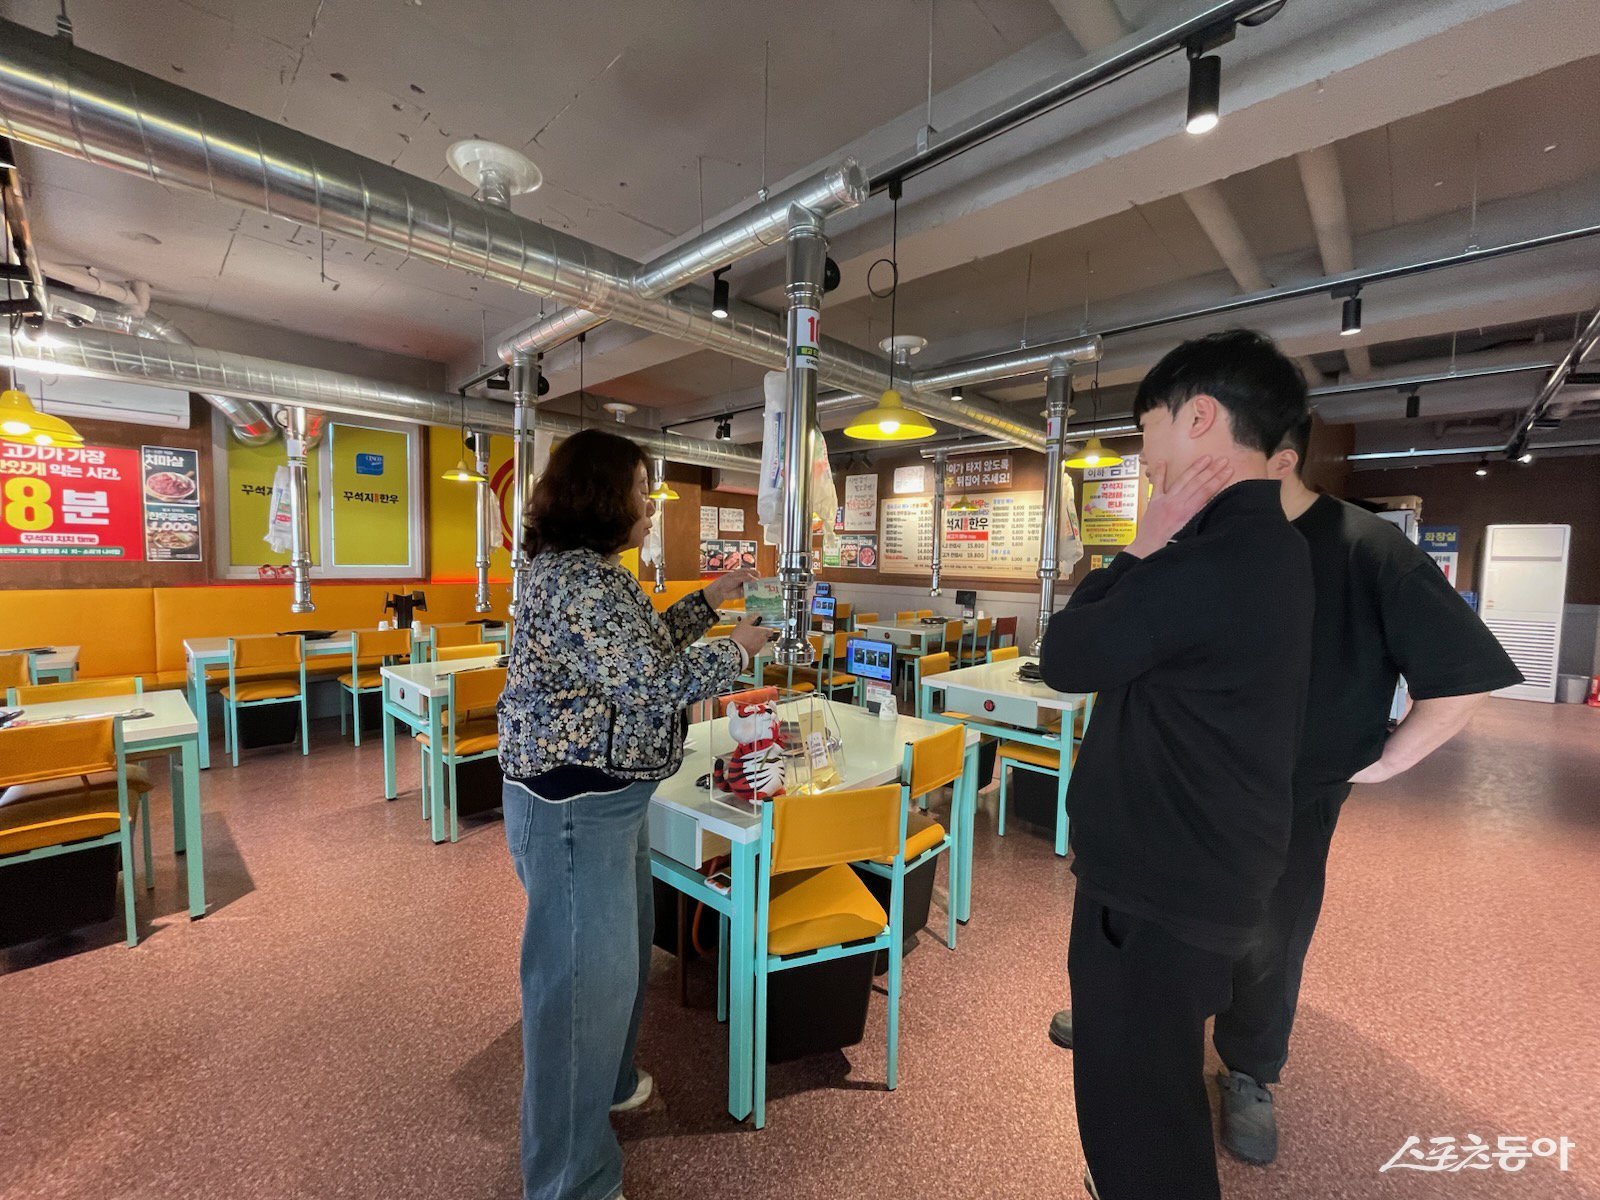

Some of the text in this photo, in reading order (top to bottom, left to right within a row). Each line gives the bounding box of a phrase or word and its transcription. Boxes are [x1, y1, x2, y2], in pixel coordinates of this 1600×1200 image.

[2, 443, 106, 465] 고기가 가장
[145, 454, 184, 468] 치마살
[50, 464, 83, 478] 익는
[86, 467, 122, 480] 시간
[946, 459, 1009, 474] 이가 타지 않도록
[944, 473, 1010, 488] 주 뒤집어 주세요!
[5, 477, 54, 531] 8
[62, 489, 109, 525] 분
[946, 517, 989, 531] 석지 한우
[1424, 532, 1457, 541] 화장실
